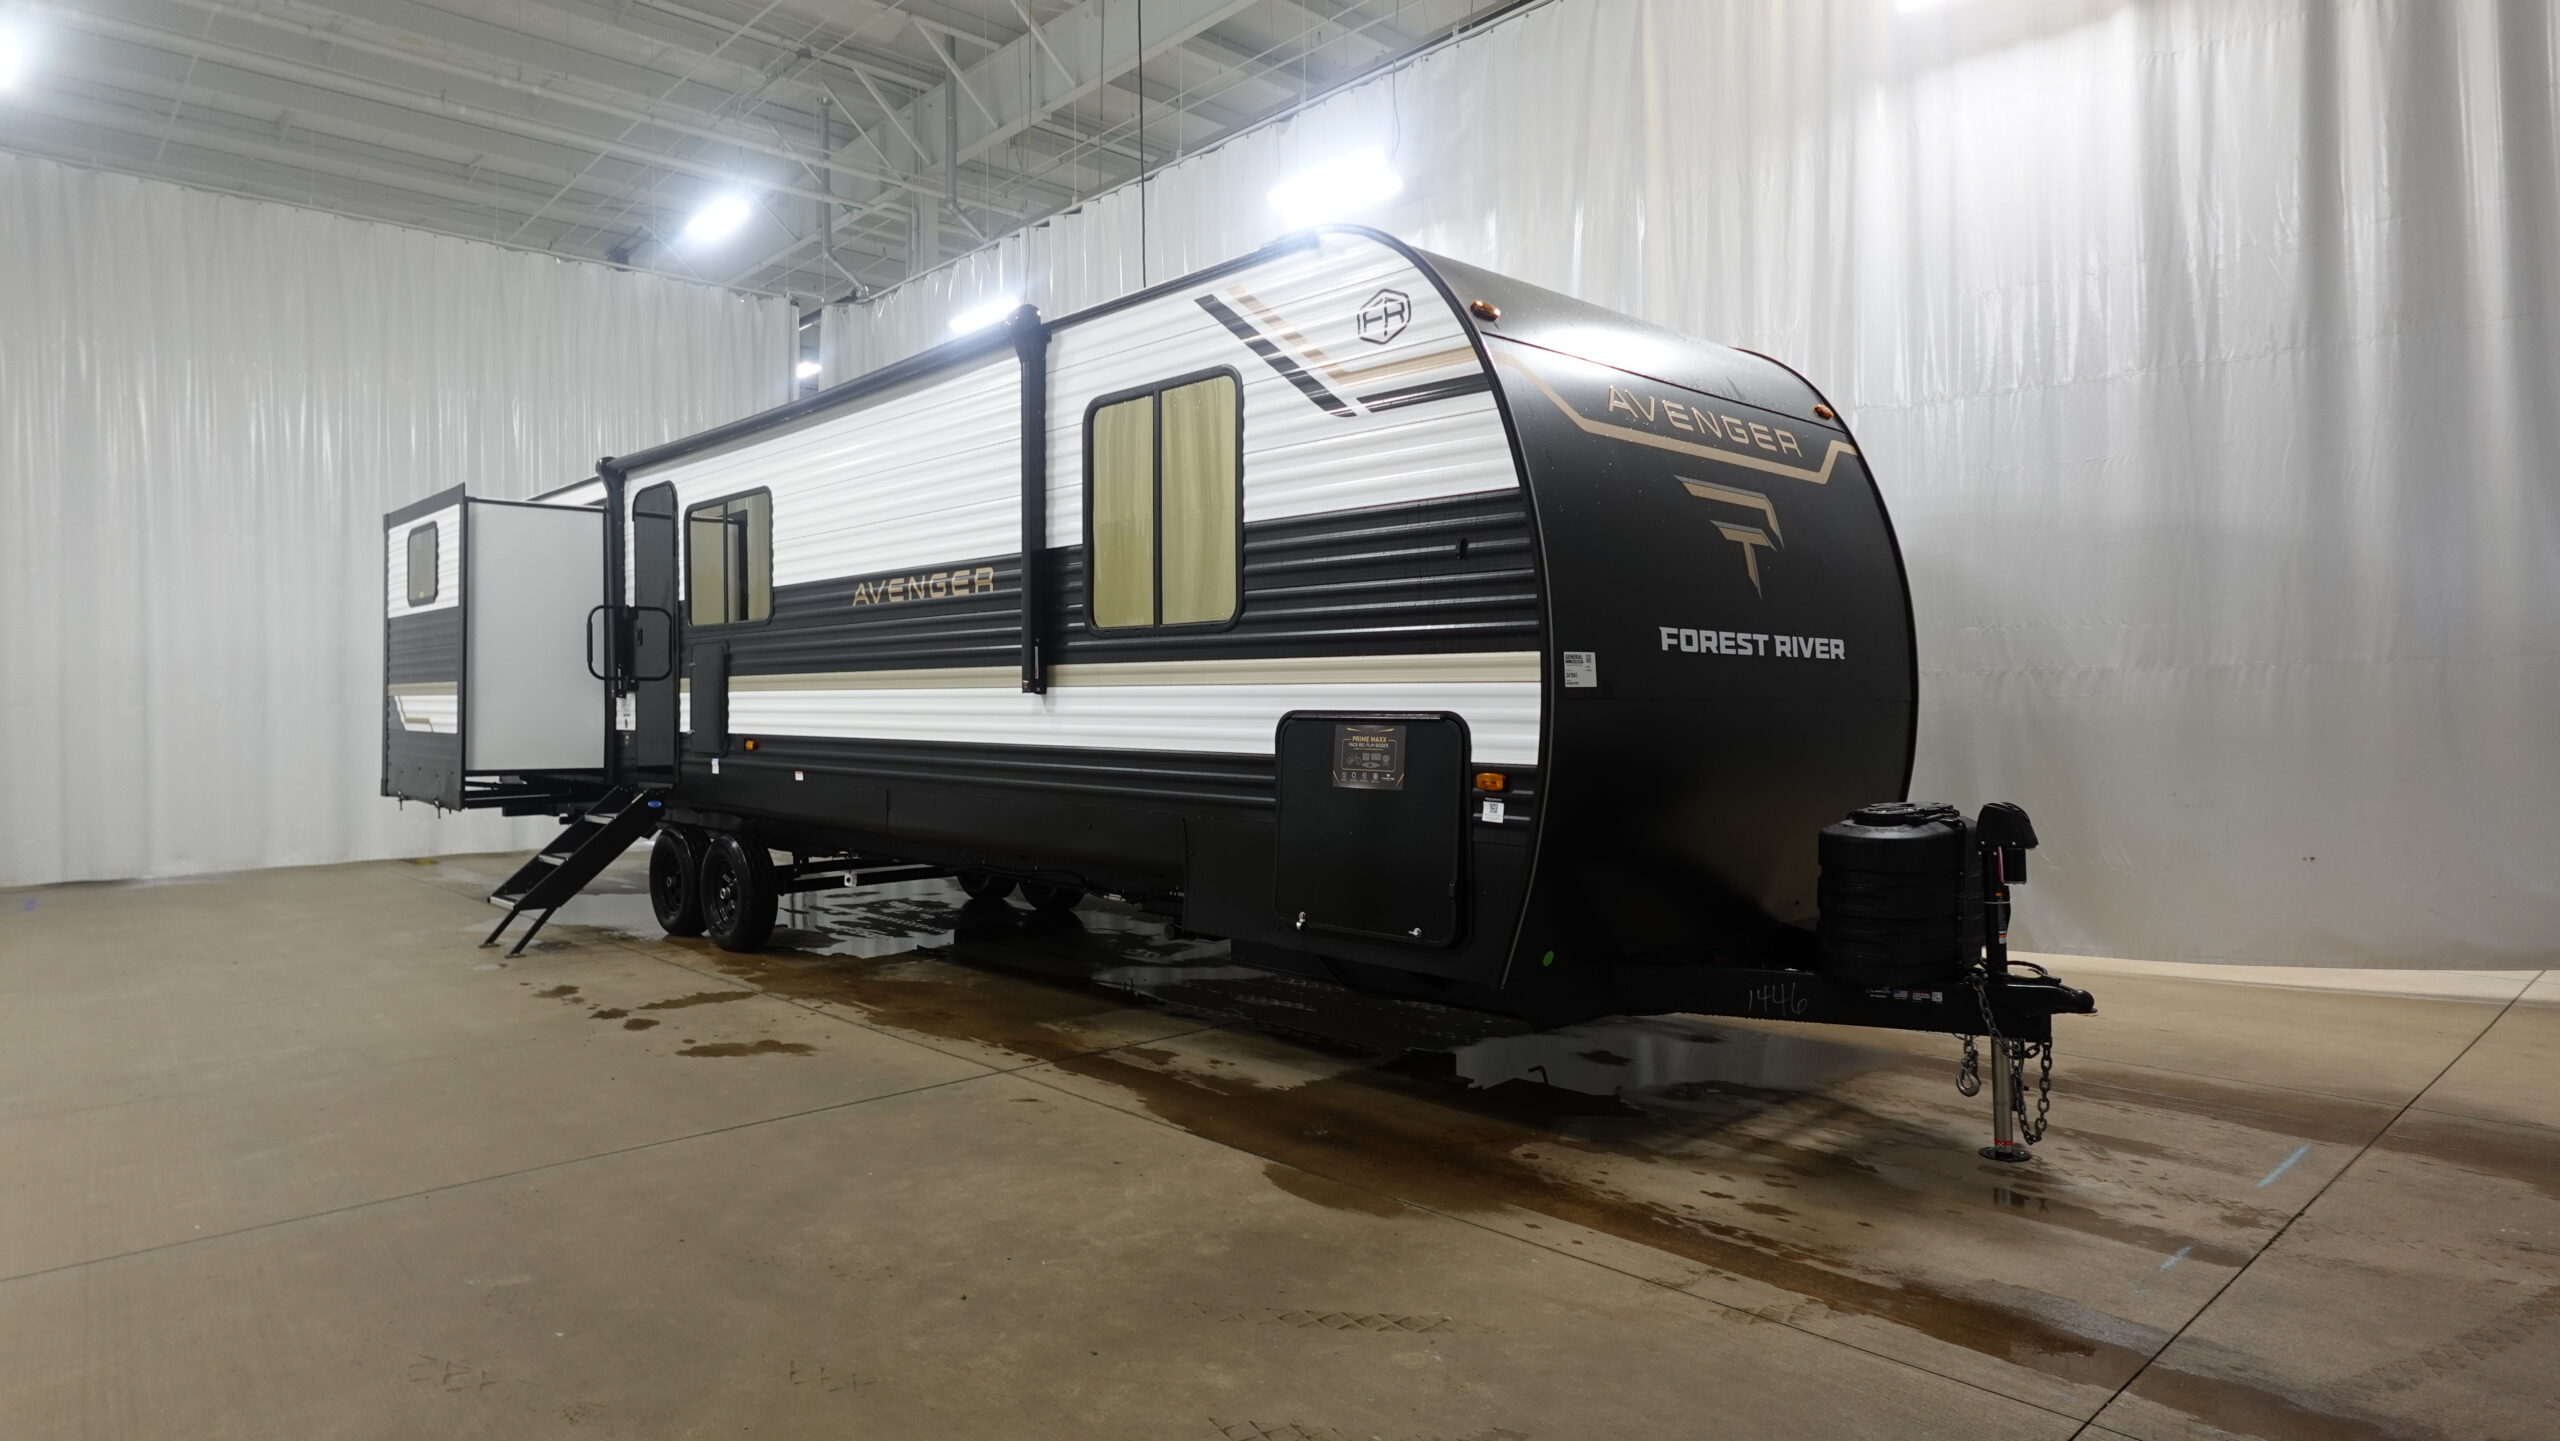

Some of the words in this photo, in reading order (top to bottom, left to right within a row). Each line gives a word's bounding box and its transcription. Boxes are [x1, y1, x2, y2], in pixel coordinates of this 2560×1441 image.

[1608, 385, 1802, 457] AVENGER
[852, 566, 994, 607] AVENGER
[1658, 626, 1769, 656] FOREST
[1773, 634, 1846, 660] RIVER
[1352, 735, 1370, 743] PRIME
[1748, 982, 1808, 1017] 1446
